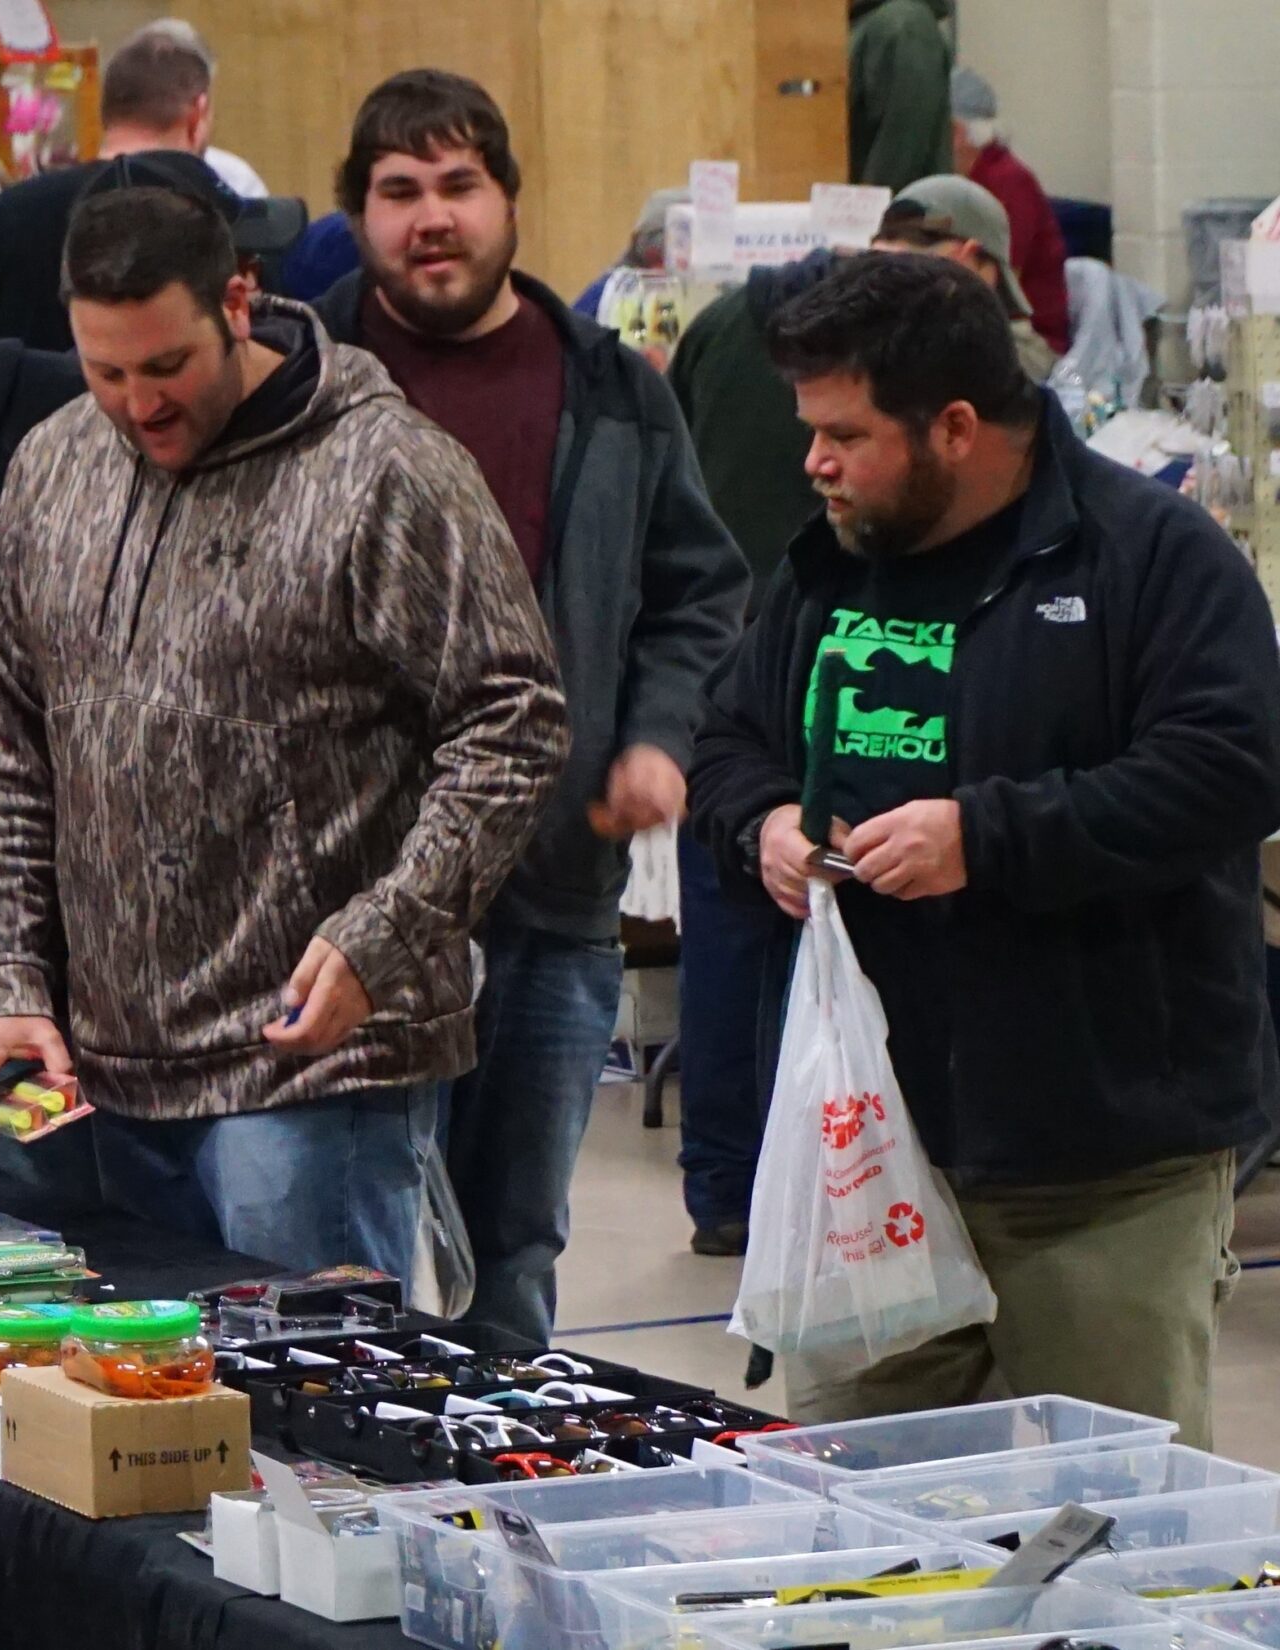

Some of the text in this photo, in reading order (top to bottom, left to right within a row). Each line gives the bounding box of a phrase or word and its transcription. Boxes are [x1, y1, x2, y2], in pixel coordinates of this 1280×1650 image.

[127, 1447, 212, 1467] THIS SIDE UP
